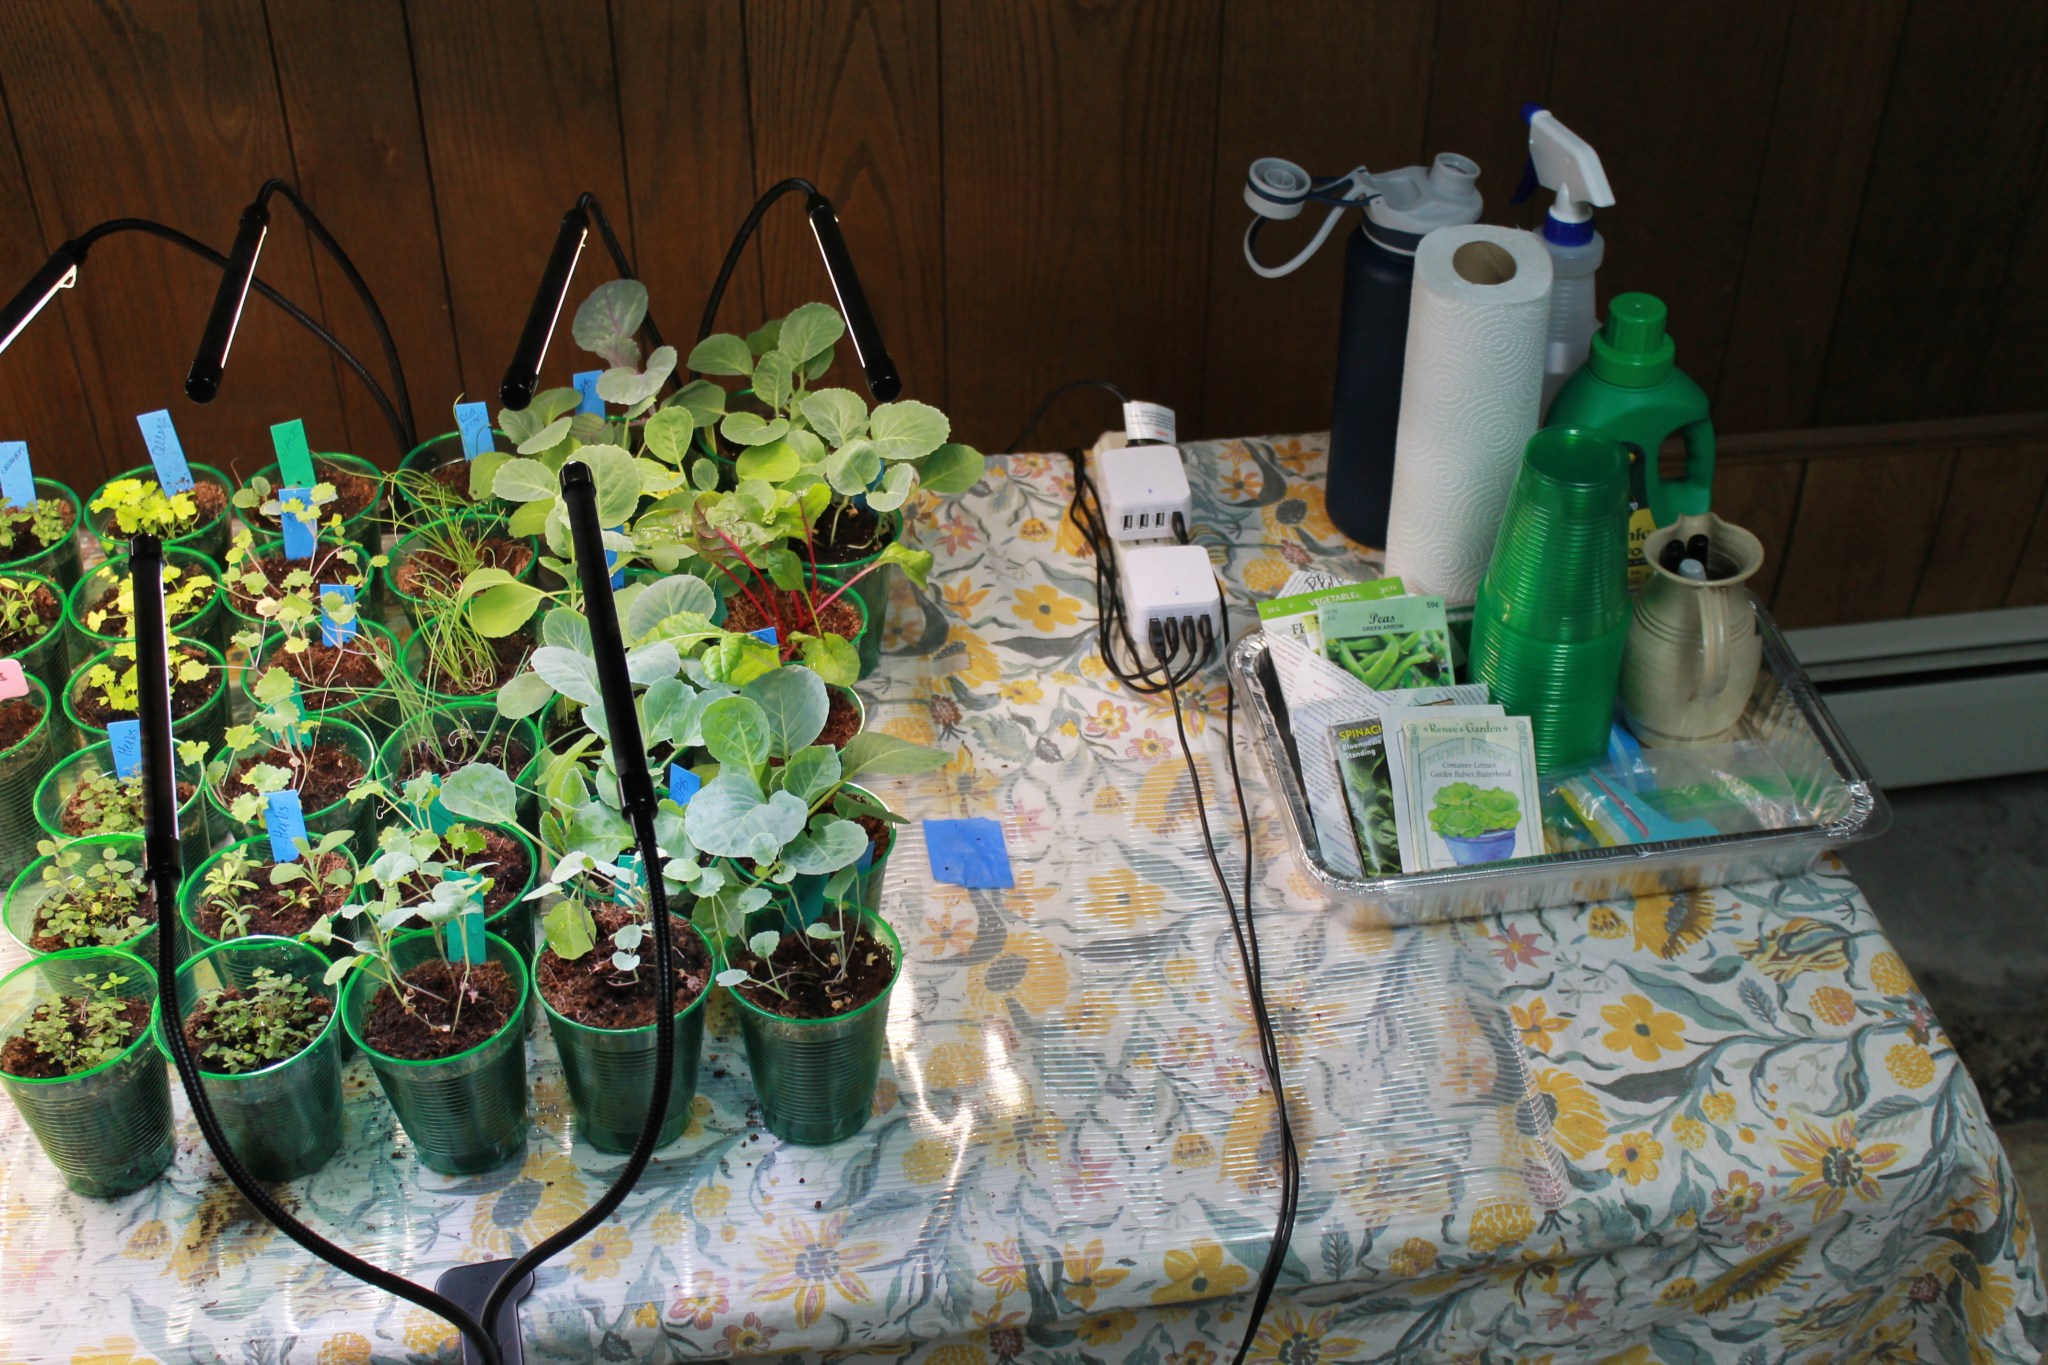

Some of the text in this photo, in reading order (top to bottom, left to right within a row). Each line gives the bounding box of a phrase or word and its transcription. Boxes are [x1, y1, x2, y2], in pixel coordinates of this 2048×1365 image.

[1426, 601, 1439, 609] 59¢
[1369, 612, 1395, 624] Peas
[1429, 721, 1502, 733] Renee's Garden
[1342, 738, 1382, 751] Bloomsdale
[1345, 748, 1376, 760] Standing
[1474, 761, 1496, 769] Lettuce
[1430, 769, 1512, 778] Garden Babies Butterhead
